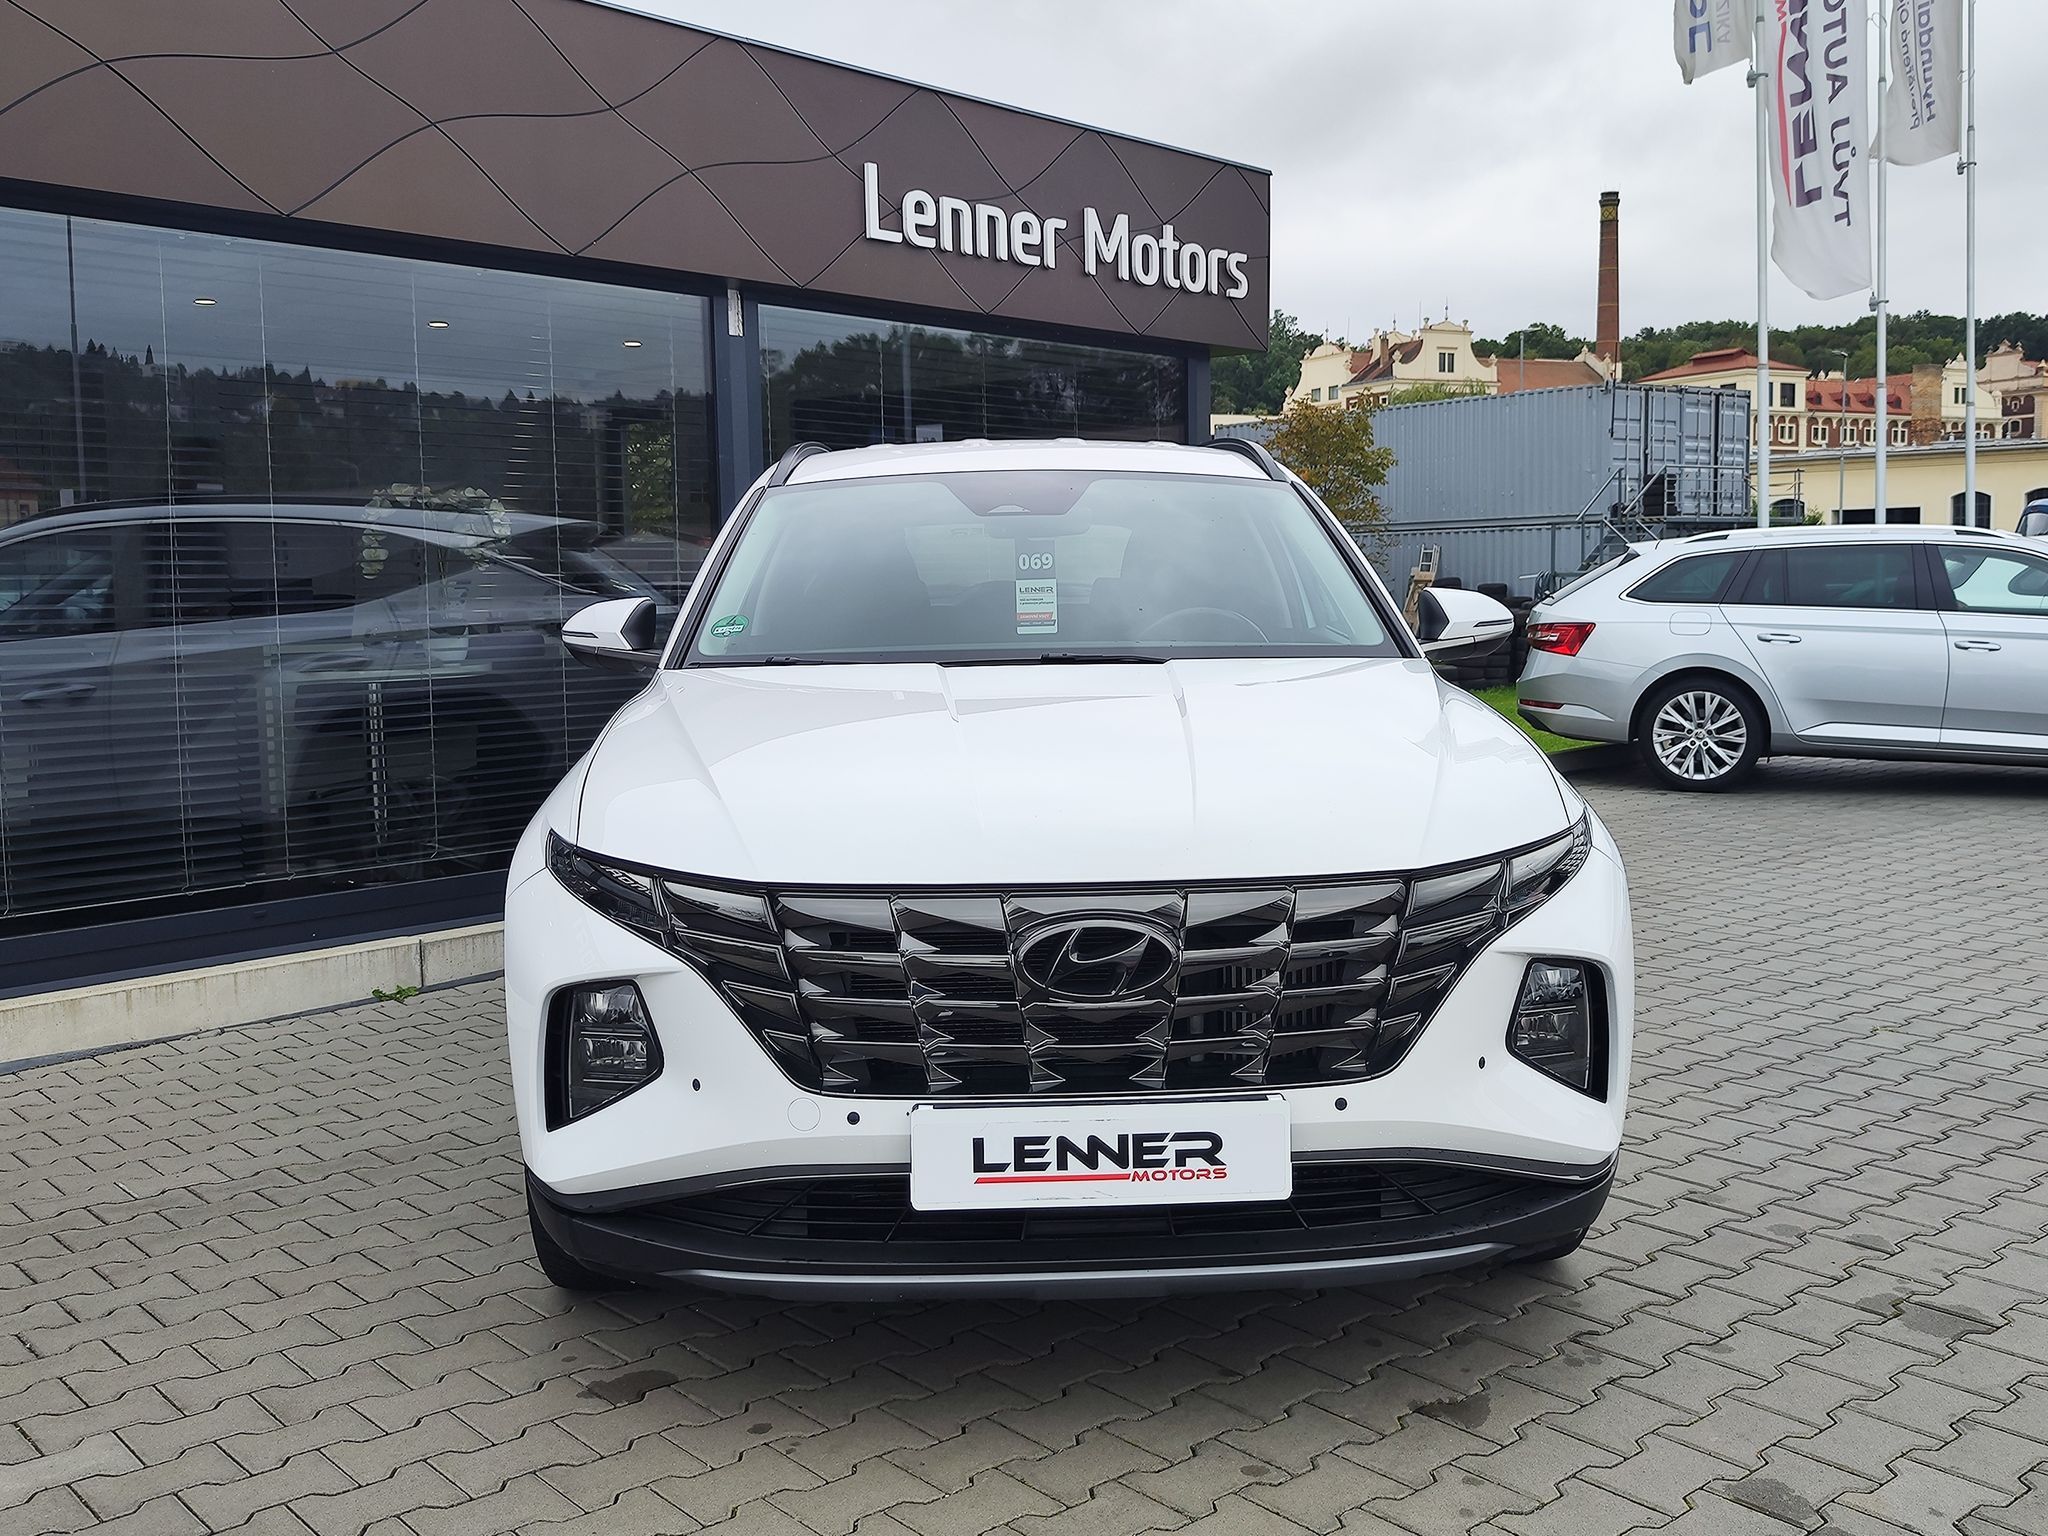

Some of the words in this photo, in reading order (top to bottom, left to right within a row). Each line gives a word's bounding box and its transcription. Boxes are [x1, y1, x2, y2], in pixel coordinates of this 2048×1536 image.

[863, 162, 1068, 270] Lenner
[1082, 207, 1249, 300] Motors
[1018, 552, 1053, 570] 069
[972, 1131, 1228, 1174] LENNER
[1131, 1167, 1228, 1182] MOTORS
